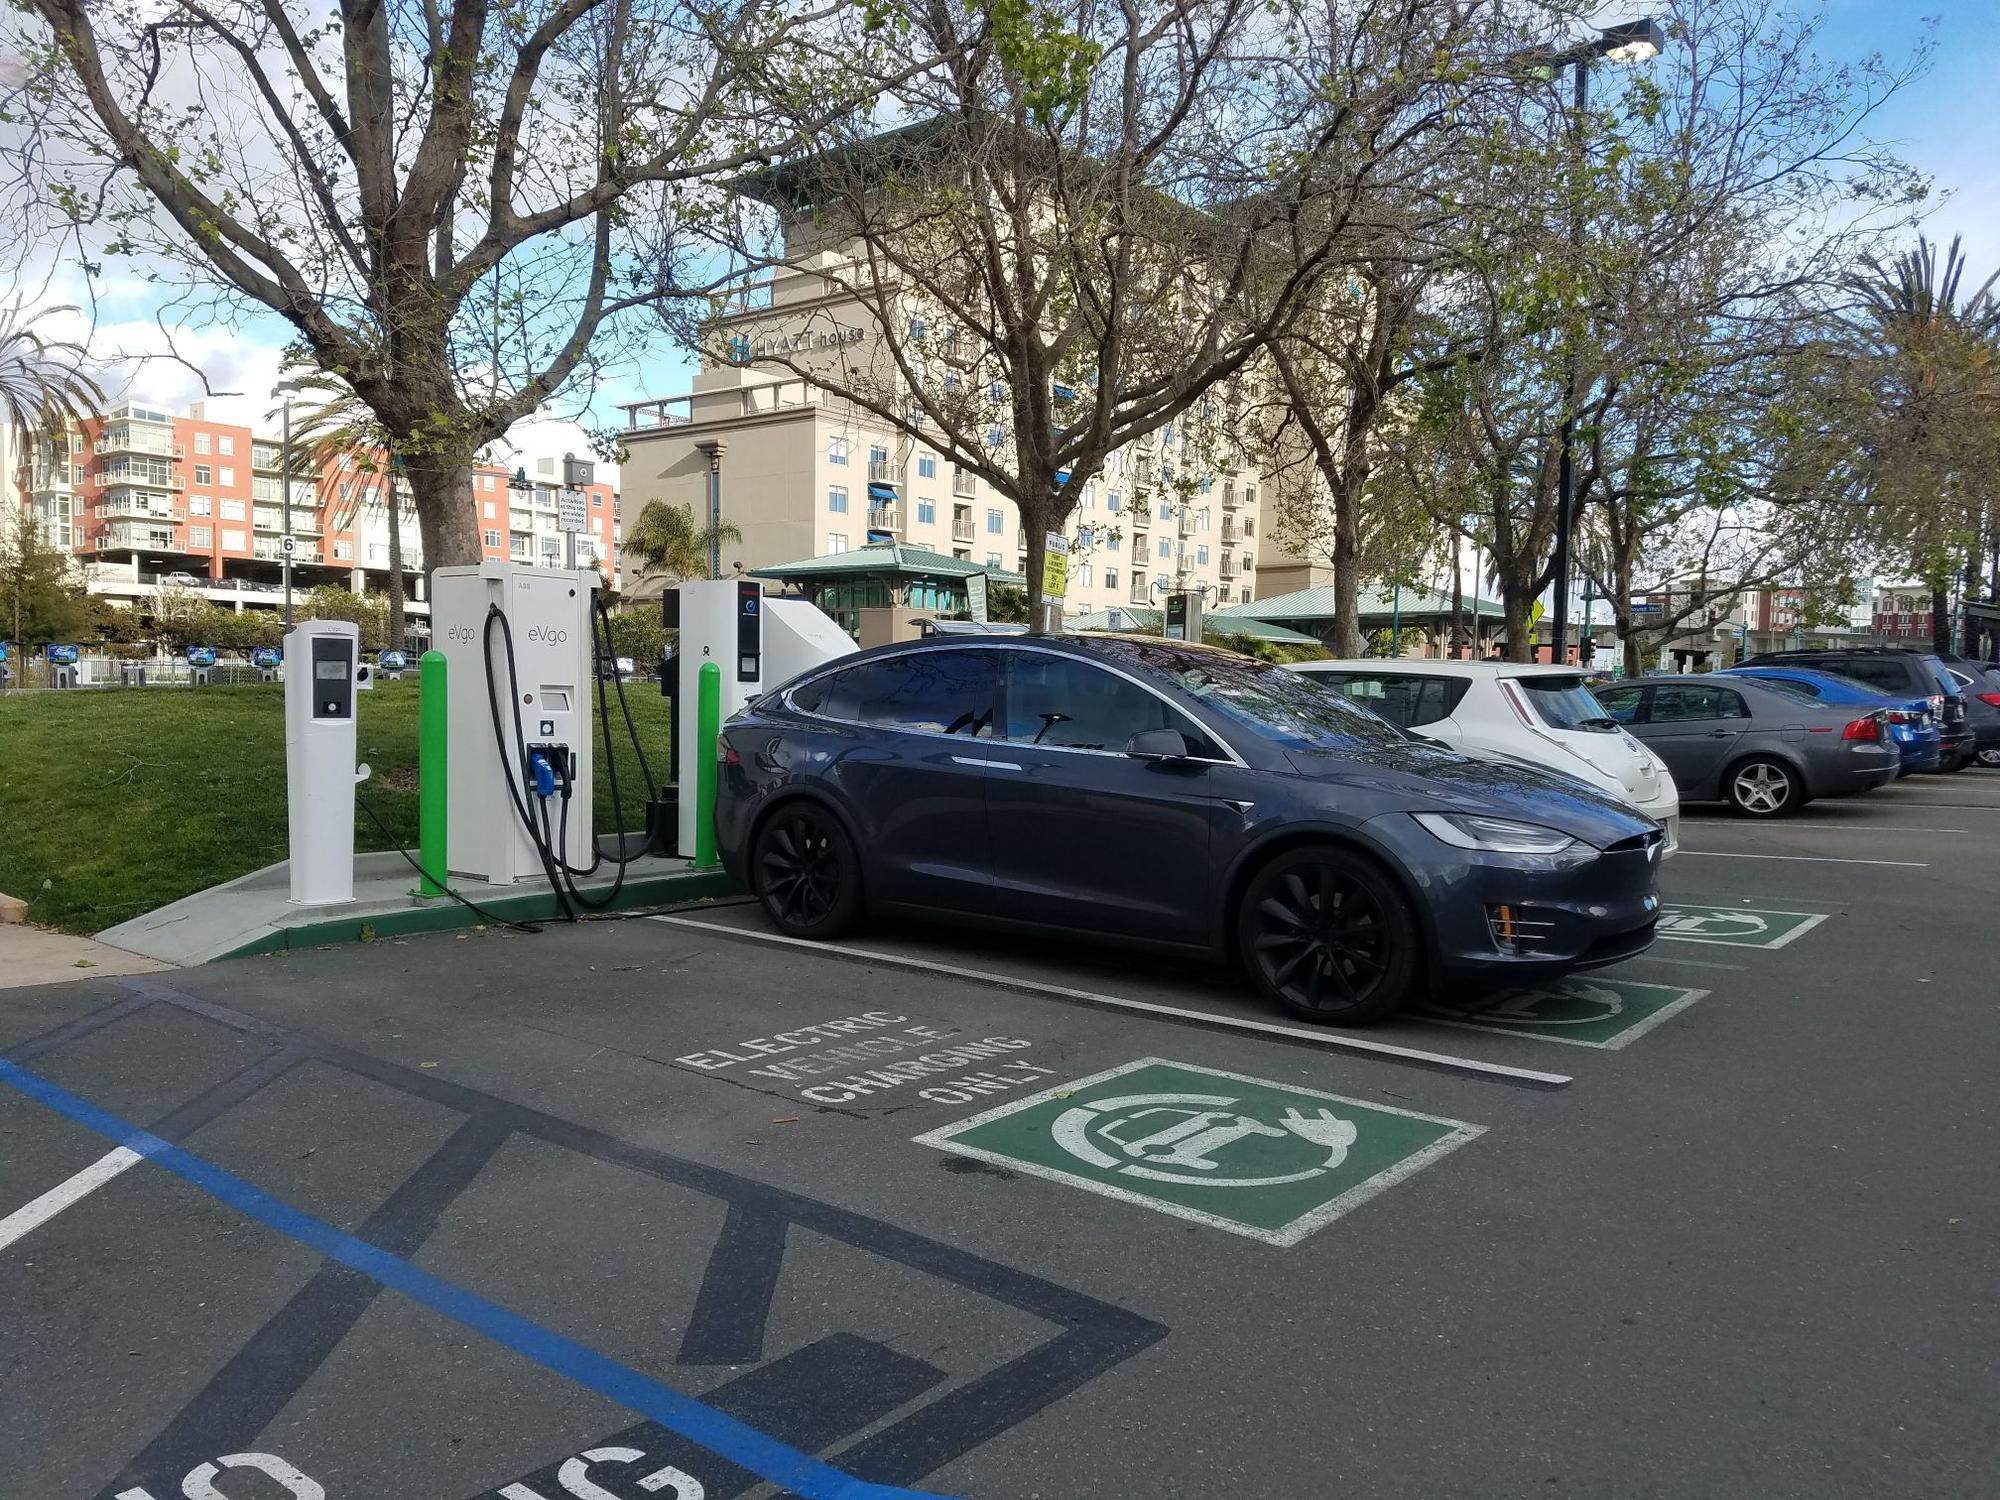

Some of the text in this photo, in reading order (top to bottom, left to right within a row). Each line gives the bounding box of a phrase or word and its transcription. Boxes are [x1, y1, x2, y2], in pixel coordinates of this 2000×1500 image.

[757, 330, 813, 357] HYATT
[820, 327, 865, 346] house
[561, 498, 584, 506] Activities
[284, 538, 294, 551] 6
[448, 624, 475, 644] eVgo
[528, 625, 568, 646] eVgo
[675, 1011, 907, 1070] ELECTRIC
[748, 1025, 954, 1080] VEHICLE
[801, 1036, 1032, 1103] CHARGING
[919, 1059, 1056, 1104] ONLY
